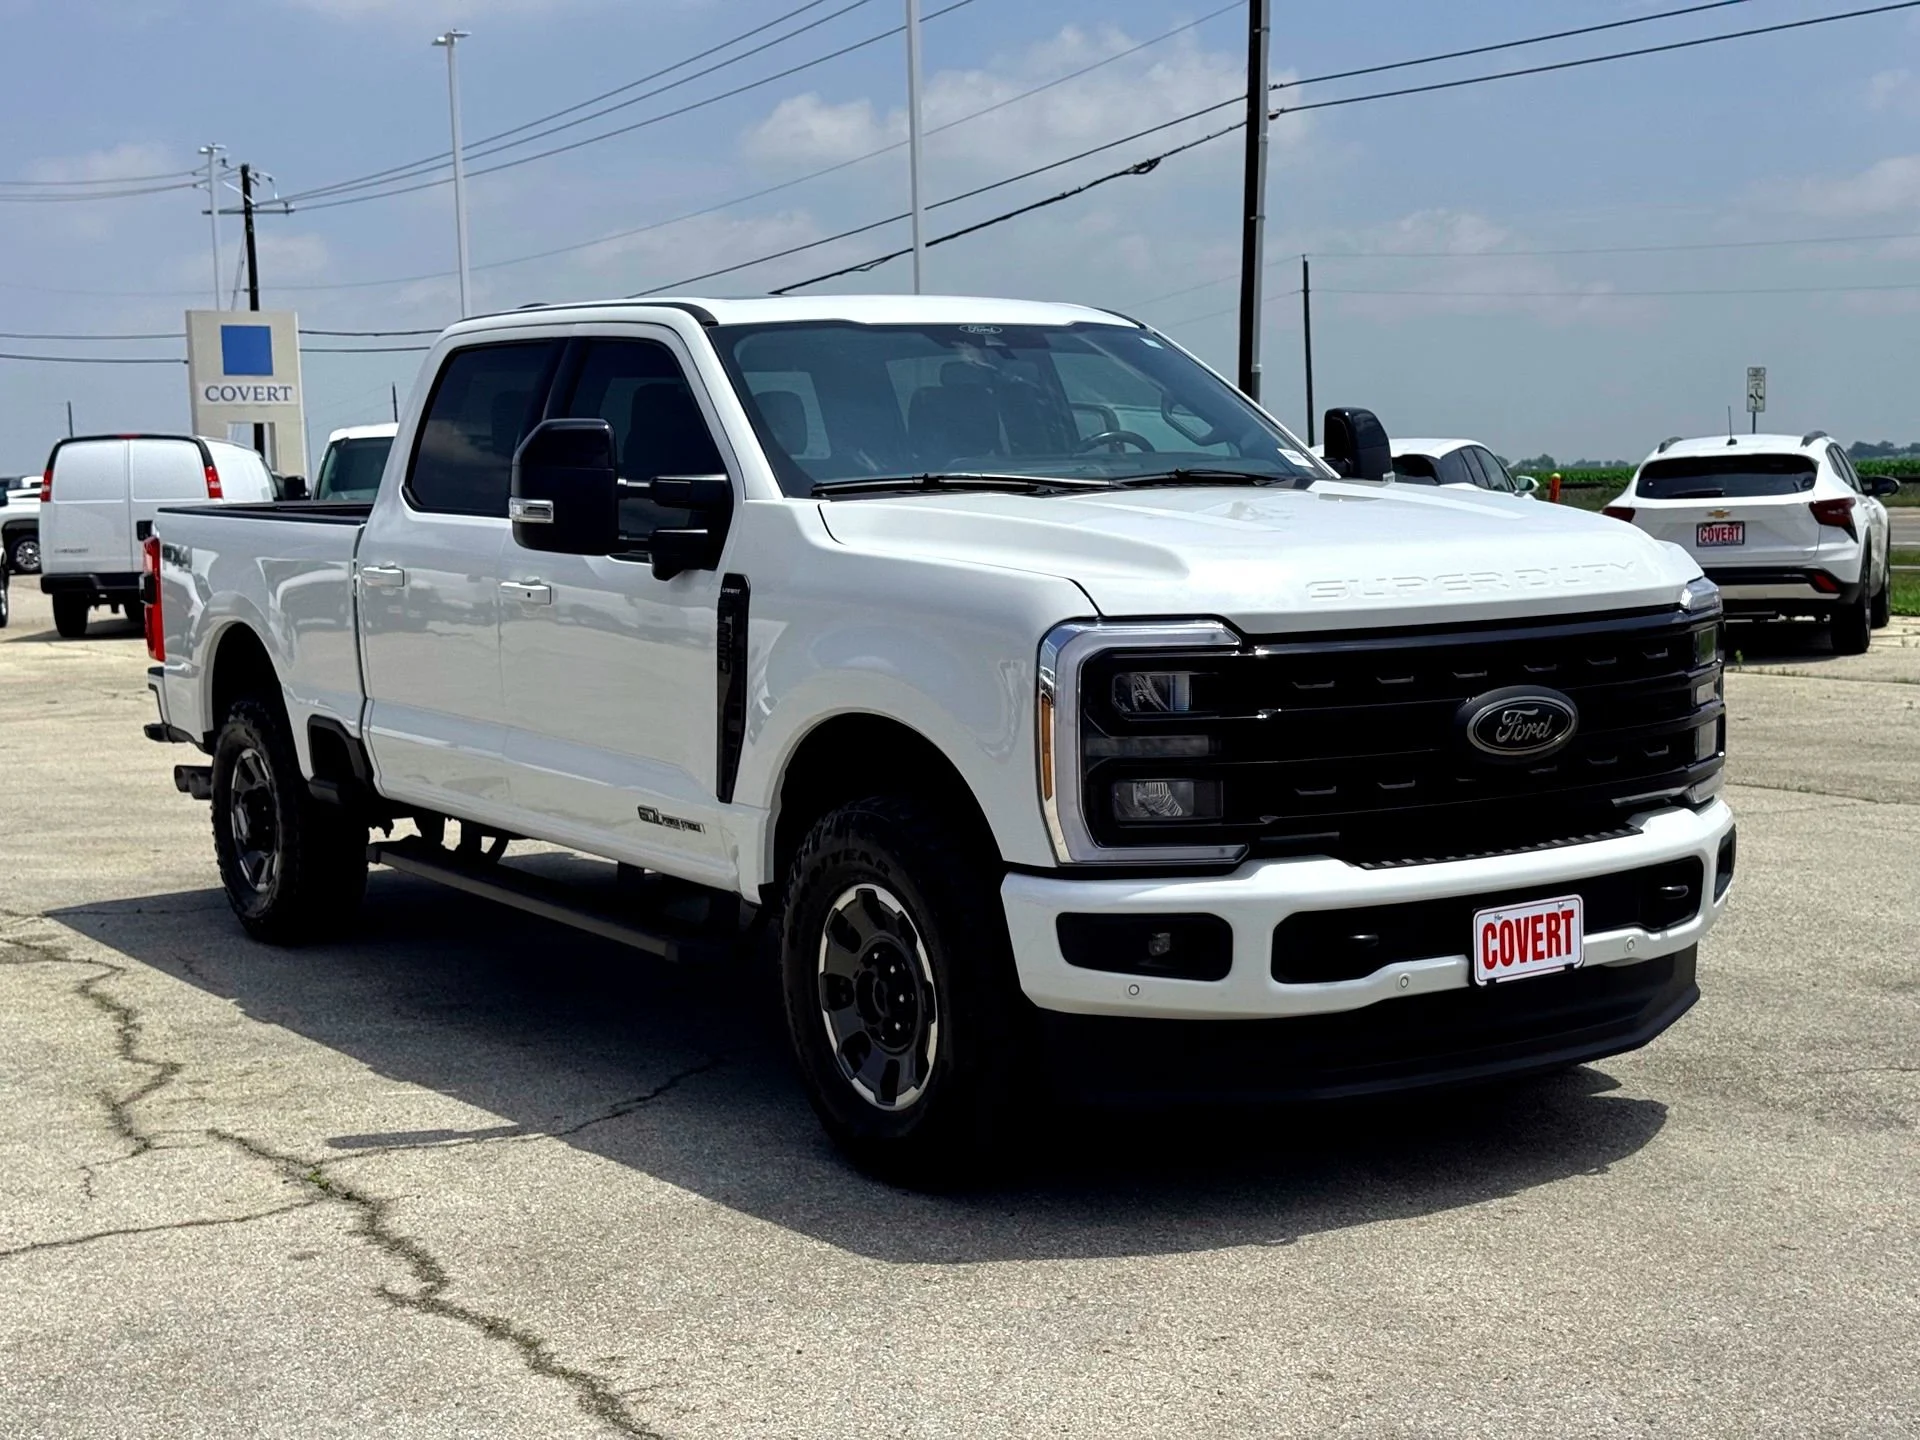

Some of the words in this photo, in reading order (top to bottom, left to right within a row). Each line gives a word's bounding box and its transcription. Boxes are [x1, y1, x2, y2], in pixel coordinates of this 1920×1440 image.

[205, 385, 293, 402] COVERT
[1700, 526, 1741, 542] COVERT
[1304, 571, 1512, 600] SUPER
[1513, 560, 1635, 589] DUTY
[1495, 708, 1553, 743] Ford
[1482, 909, 1575, 971] COVERT
